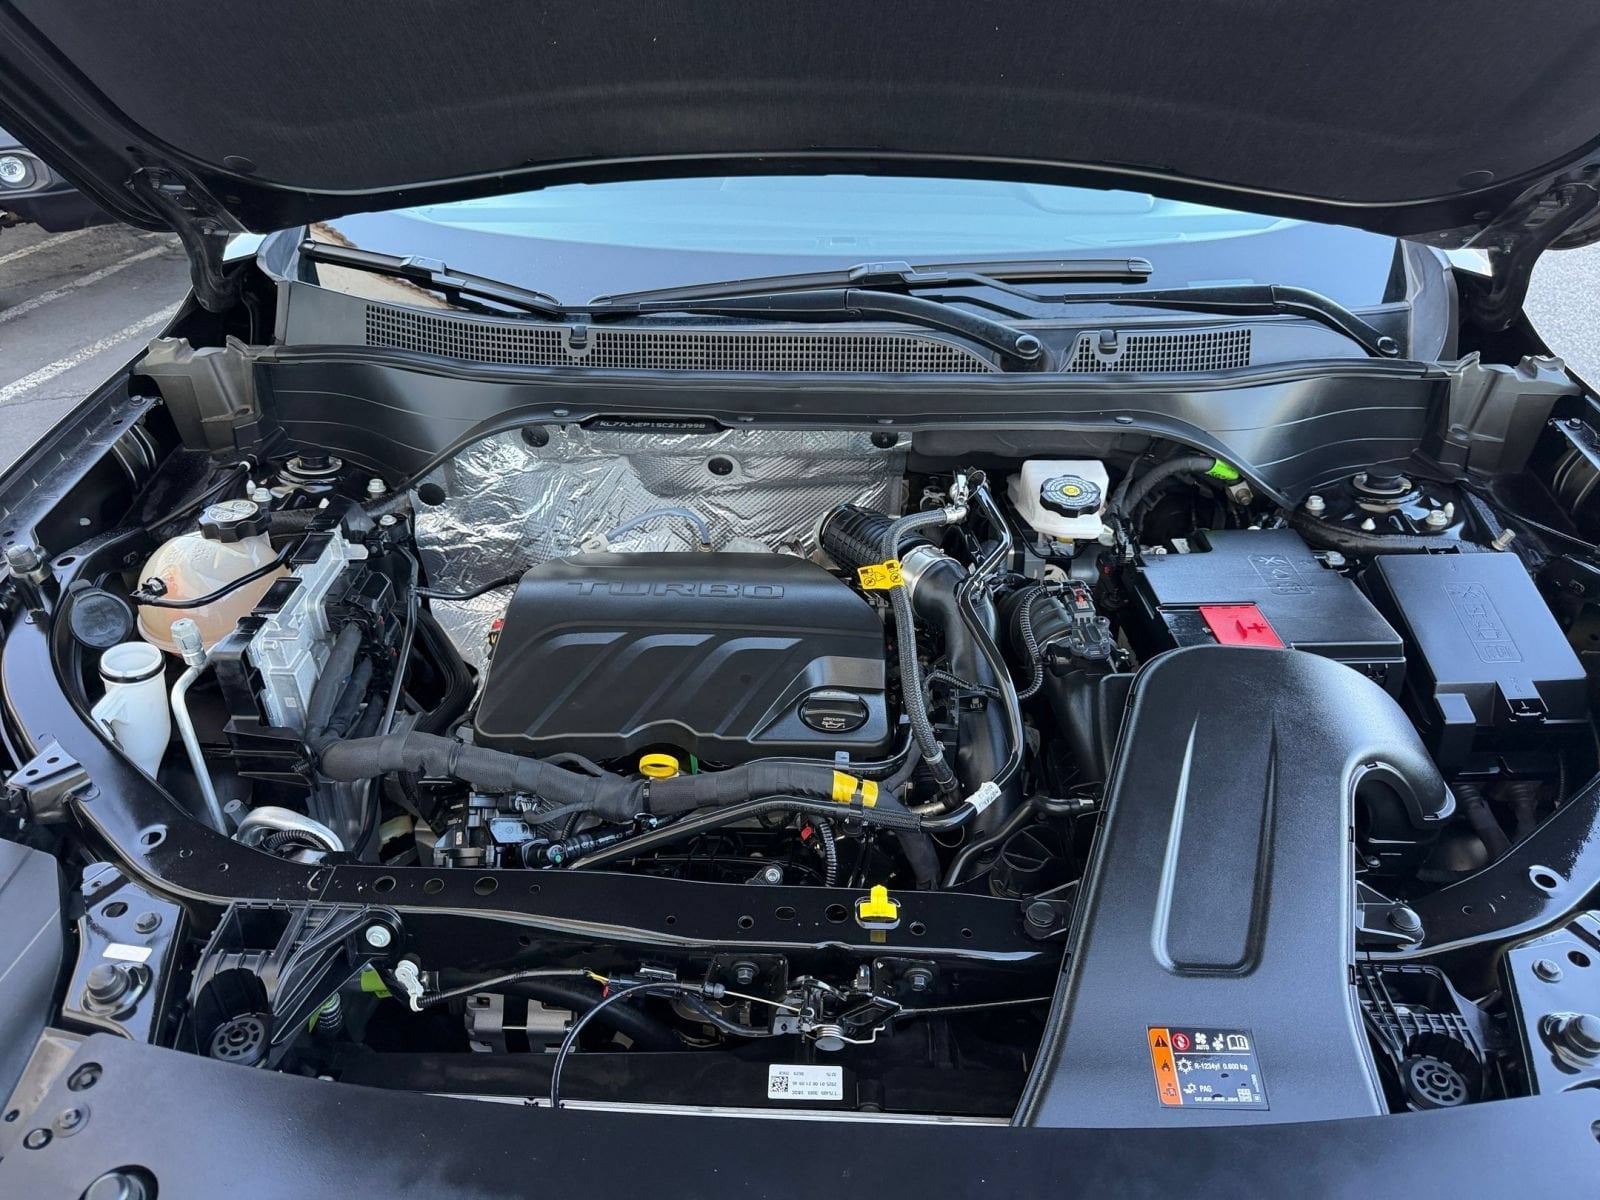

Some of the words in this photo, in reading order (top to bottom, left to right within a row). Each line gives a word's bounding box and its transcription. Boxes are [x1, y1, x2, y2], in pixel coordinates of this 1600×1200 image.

[567, 581, 785, 599] TURBO
[1194, 1062, 1220, 1071] R-1234yf
[1239, 1063, 1248, 1071] kg
[1199, 1085, 1212, 1093] PAG
